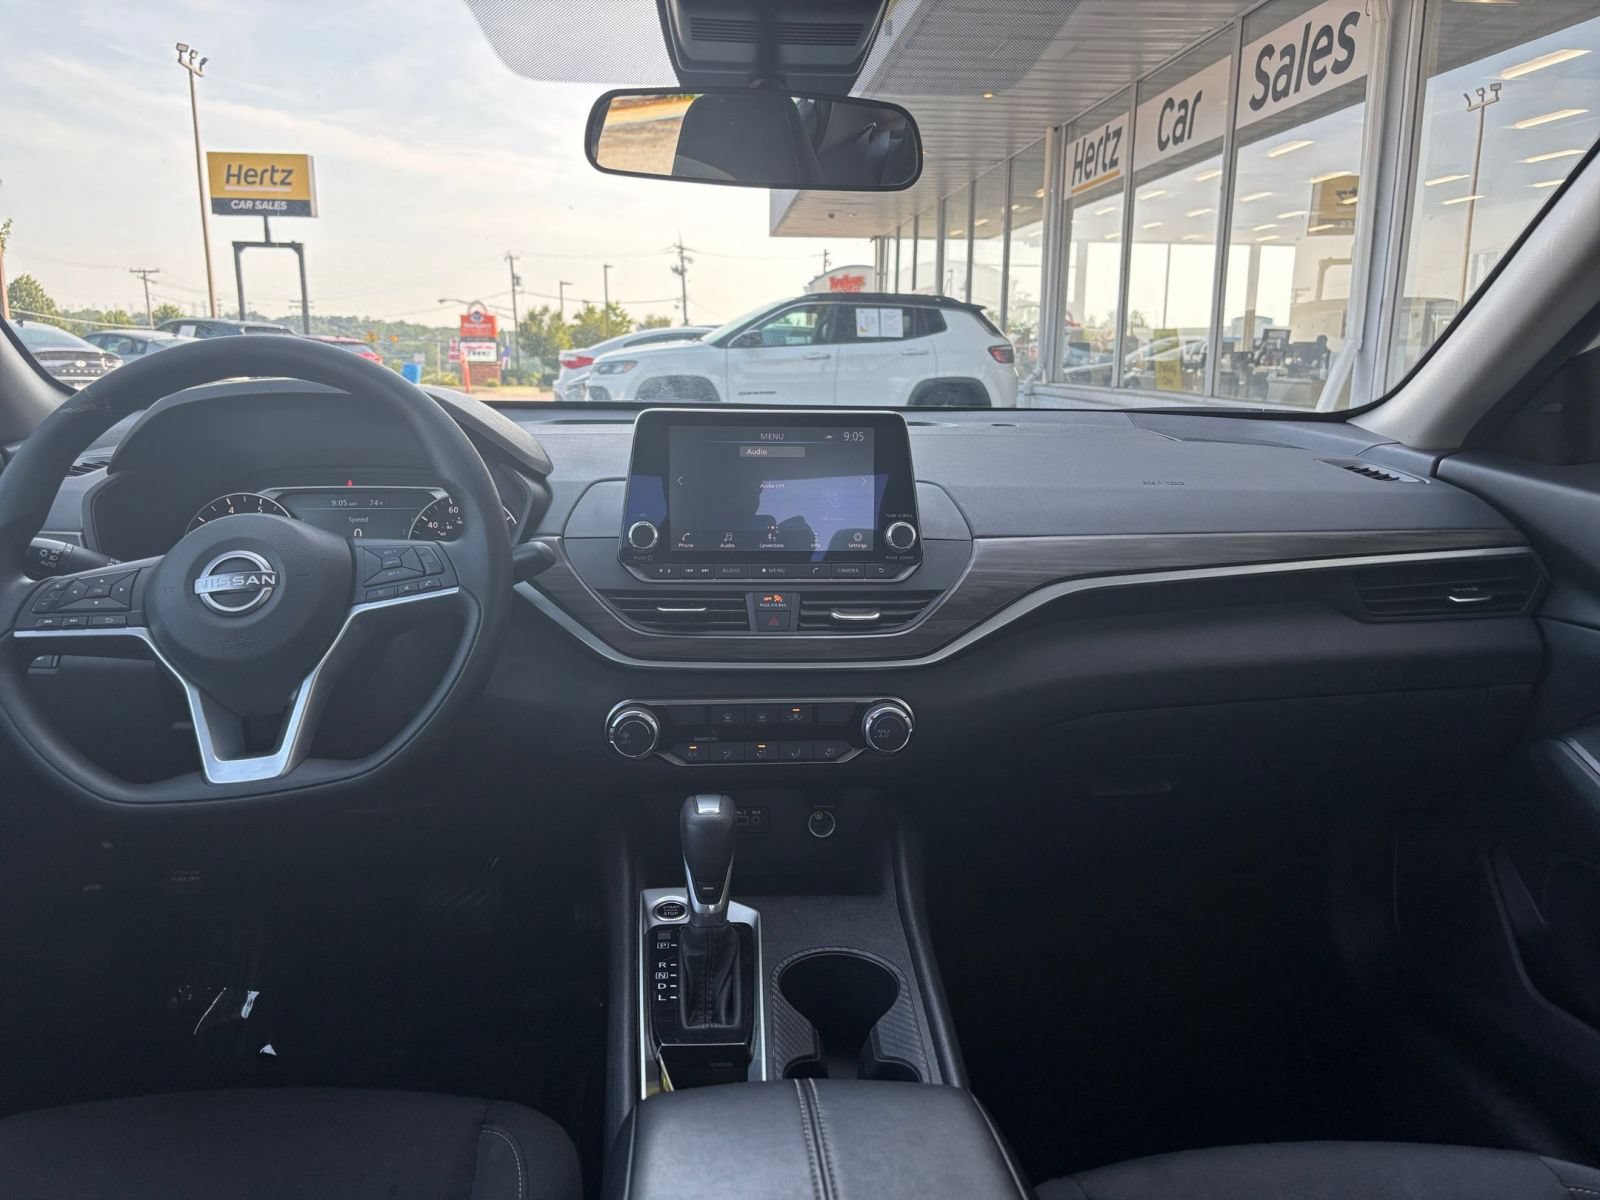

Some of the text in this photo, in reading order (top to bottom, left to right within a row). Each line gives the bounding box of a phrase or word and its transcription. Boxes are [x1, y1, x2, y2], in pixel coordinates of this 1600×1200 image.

[1071, 10, 1360, 185] Hertz Car Sales
[225, 164, 294, 187] Hertz
[231, 200, 288, 210] CAR SALES
[760, 432, 784, 441] MENU
[843, 431, 864, 442] 9:05
[746, 447, 768, 456] Audio
[331, 499, 348, 507] 9:05
[228, 506, 235, 514] 4
[257, 506, 264, 514] 5
[448, 506, 459, 514] 60
[347, 515, 369, 524] Speed
[427, 521, 439, 529] 40
[40, 560, 56, 569] AUTO
[199, 575, 276, 590] NISSAN
